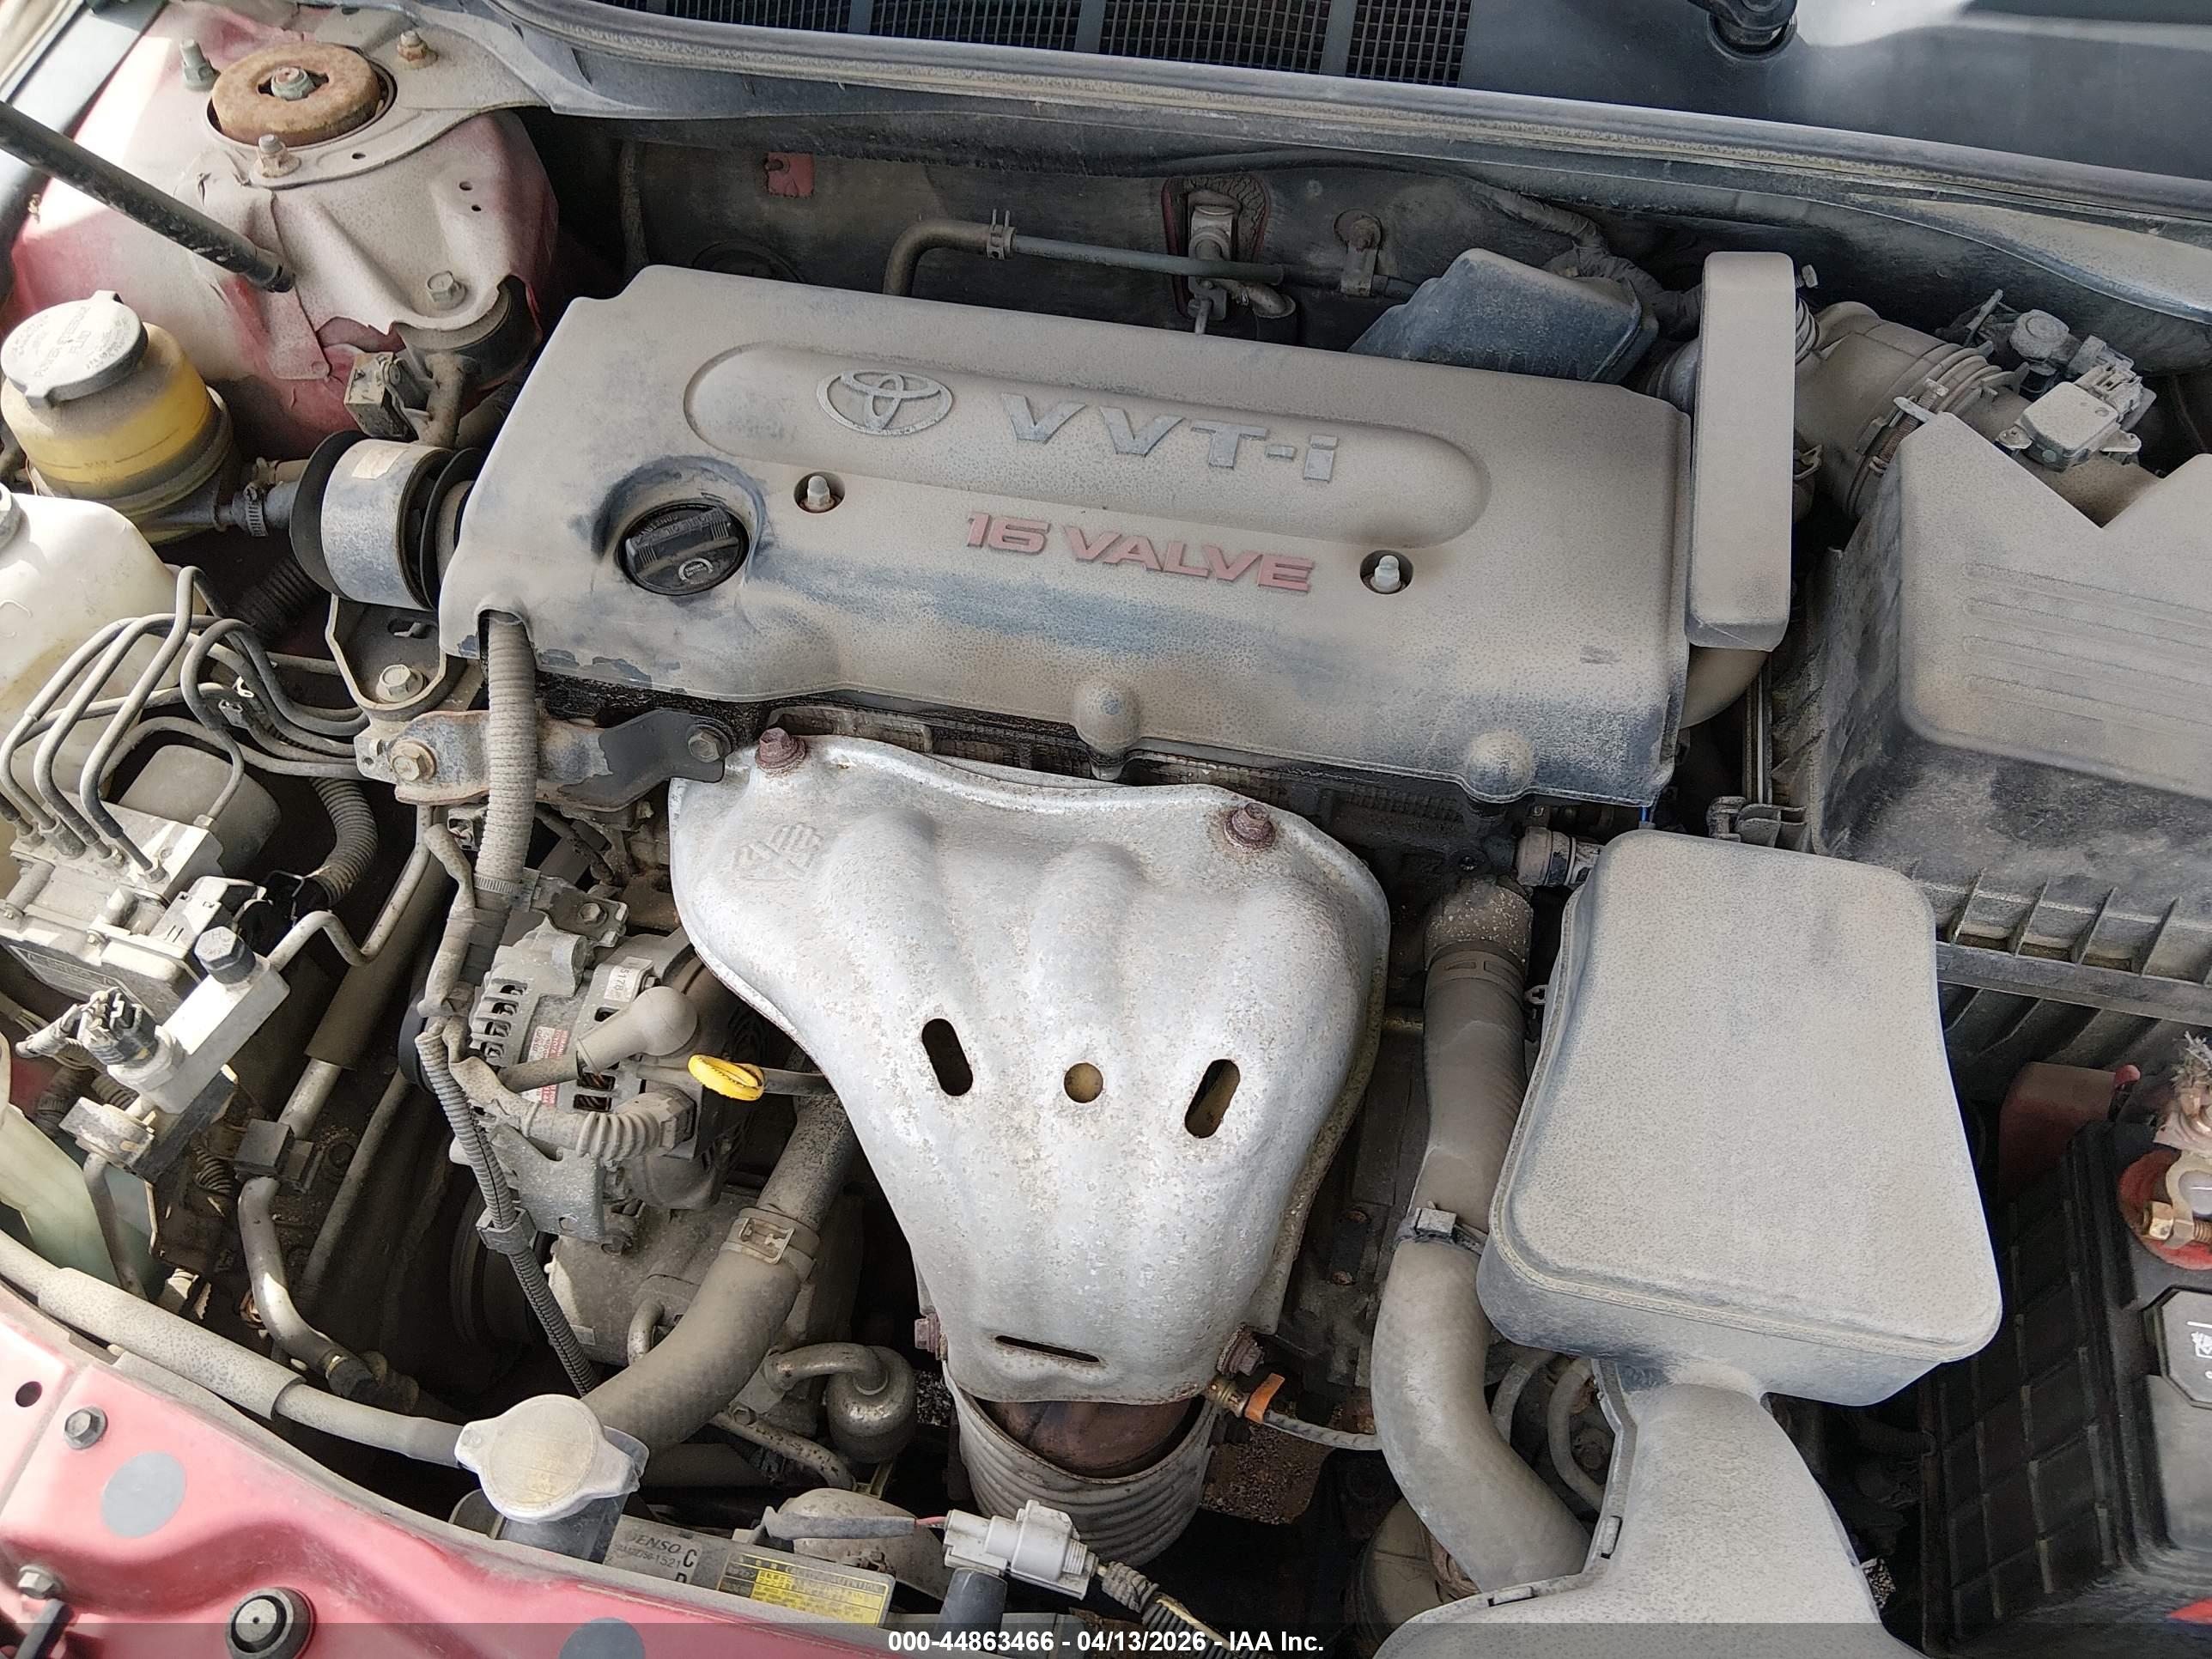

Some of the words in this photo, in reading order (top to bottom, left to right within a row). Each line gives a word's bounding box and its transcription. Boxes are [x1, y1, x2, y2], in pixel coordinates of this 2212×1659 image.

[1001, 392, 1338, 483] VVT-i
[967, 512, 1050, 555] 16
[1063, 525, 1314, 592] VALVE
[624, 1529, 682, 1554] DENSO
[683, 1548, 697, 1568] C
